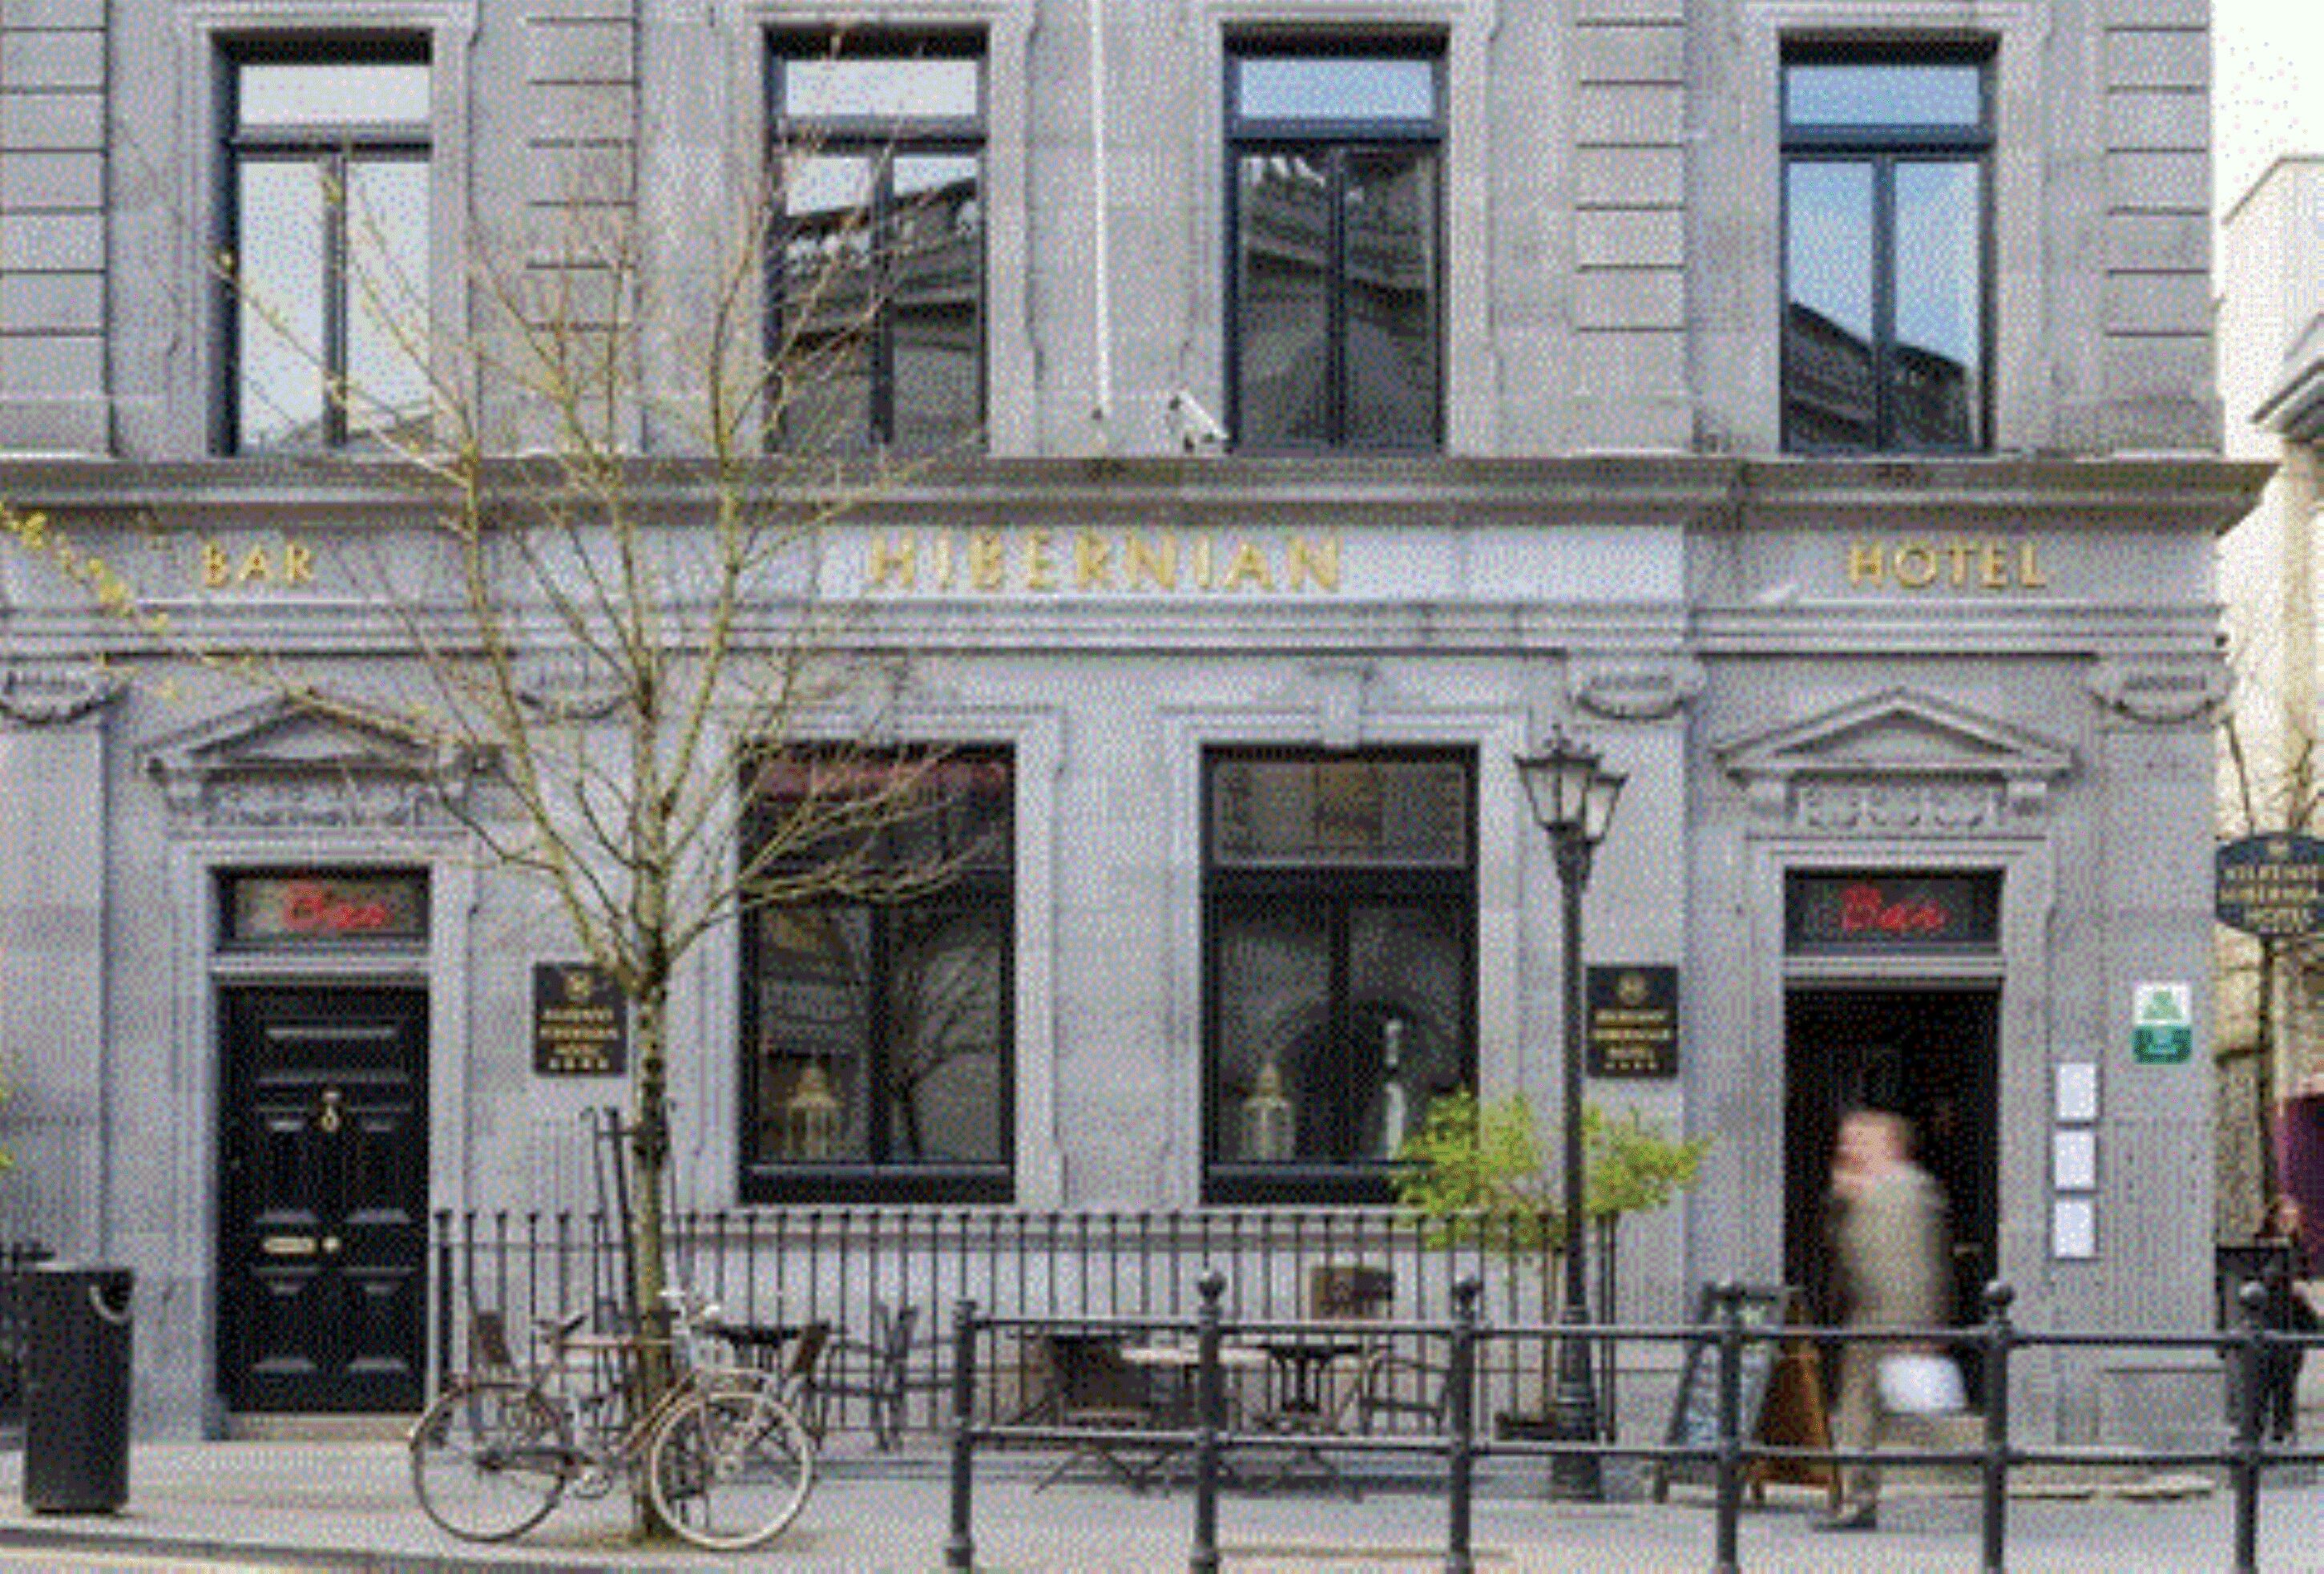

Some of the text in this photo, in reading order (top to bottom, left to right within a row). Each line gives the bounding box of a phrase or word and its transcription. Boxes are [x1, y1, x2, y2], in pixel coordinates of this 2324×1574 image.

[202, 539, 316, 588] BAR
[869, 531, 1340, 591] HIBERNIAN
[1848, 540, 2048, 589] HOTEL
